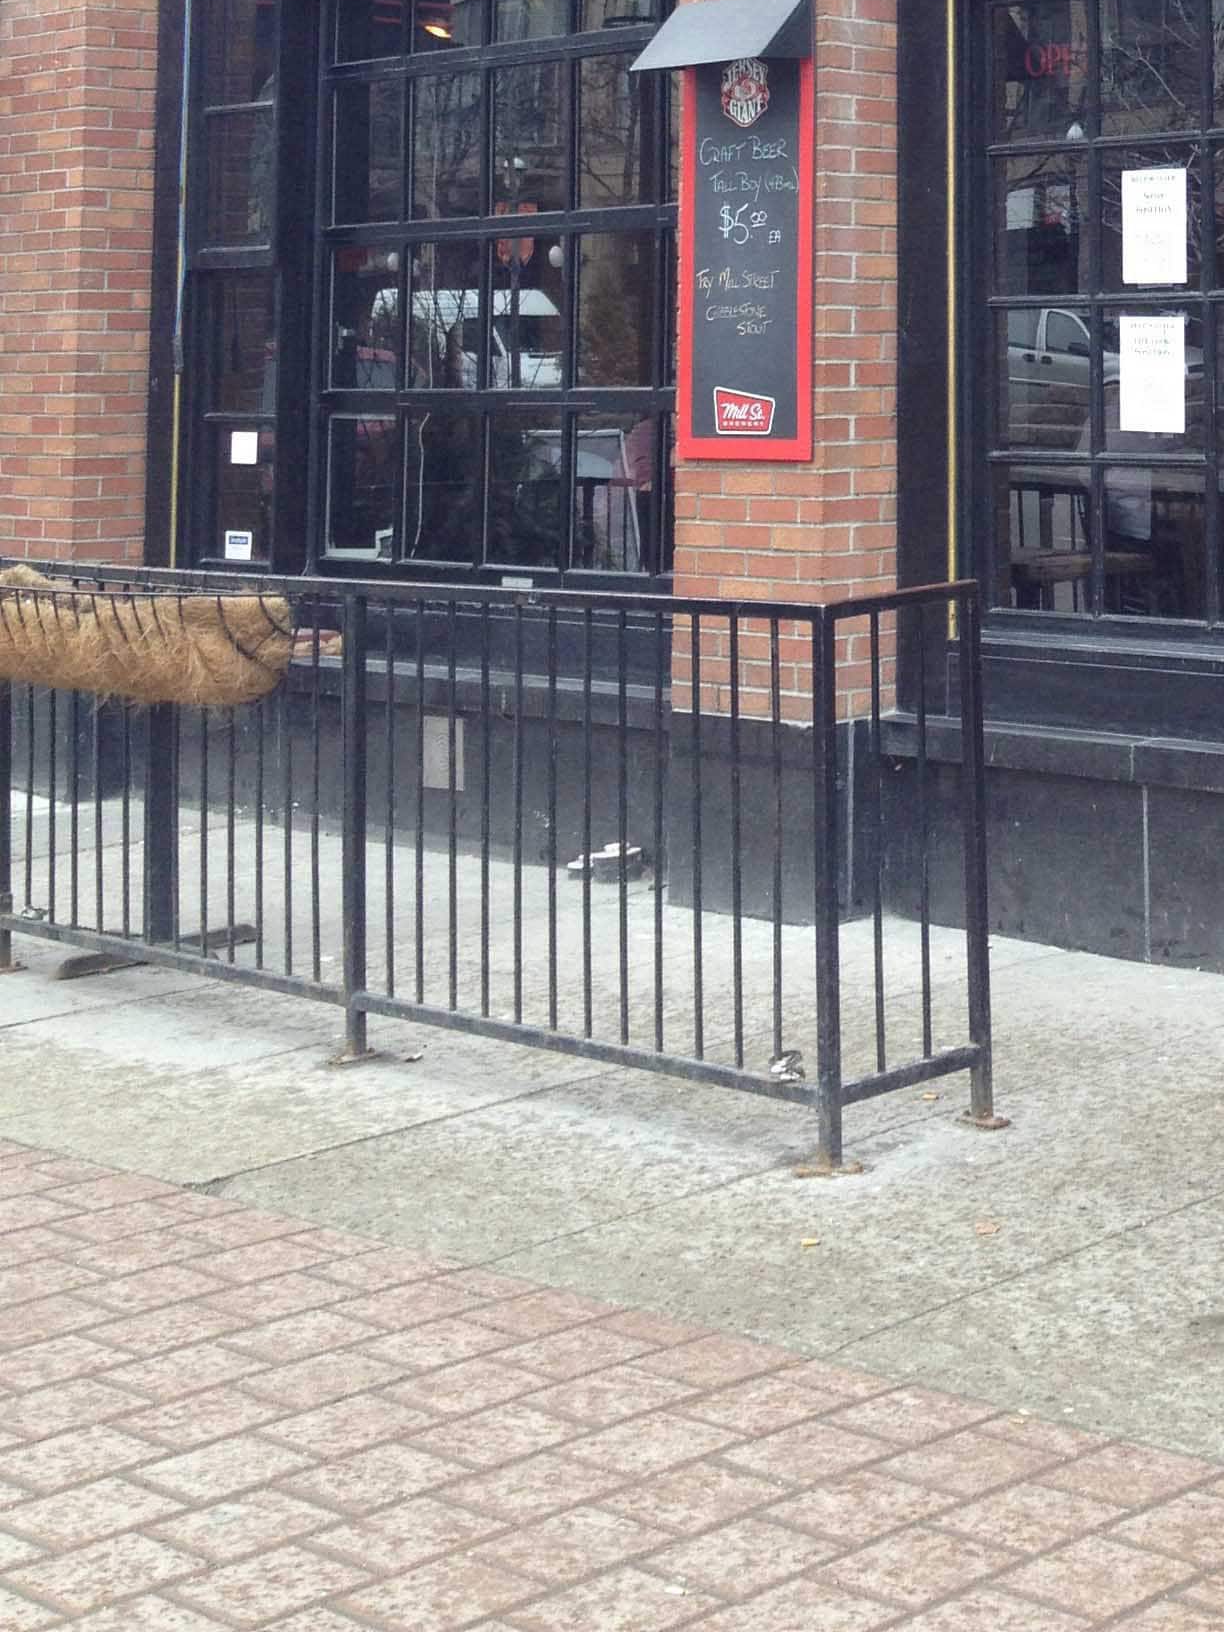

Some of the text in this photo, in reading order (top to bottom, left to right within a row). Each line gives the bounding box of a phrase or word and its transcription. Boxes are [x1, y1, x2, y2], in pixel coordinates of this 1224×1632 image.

[728, 95, 763, 125] GIANT
[700, 135, 788, 166] CRAFT BEER
[695, 268, 714, 299] TRY
[741, 269, 781, 289] STREET
[736, 319, 774, 336] STOUT
[720, 402, 750, 421] Mill
